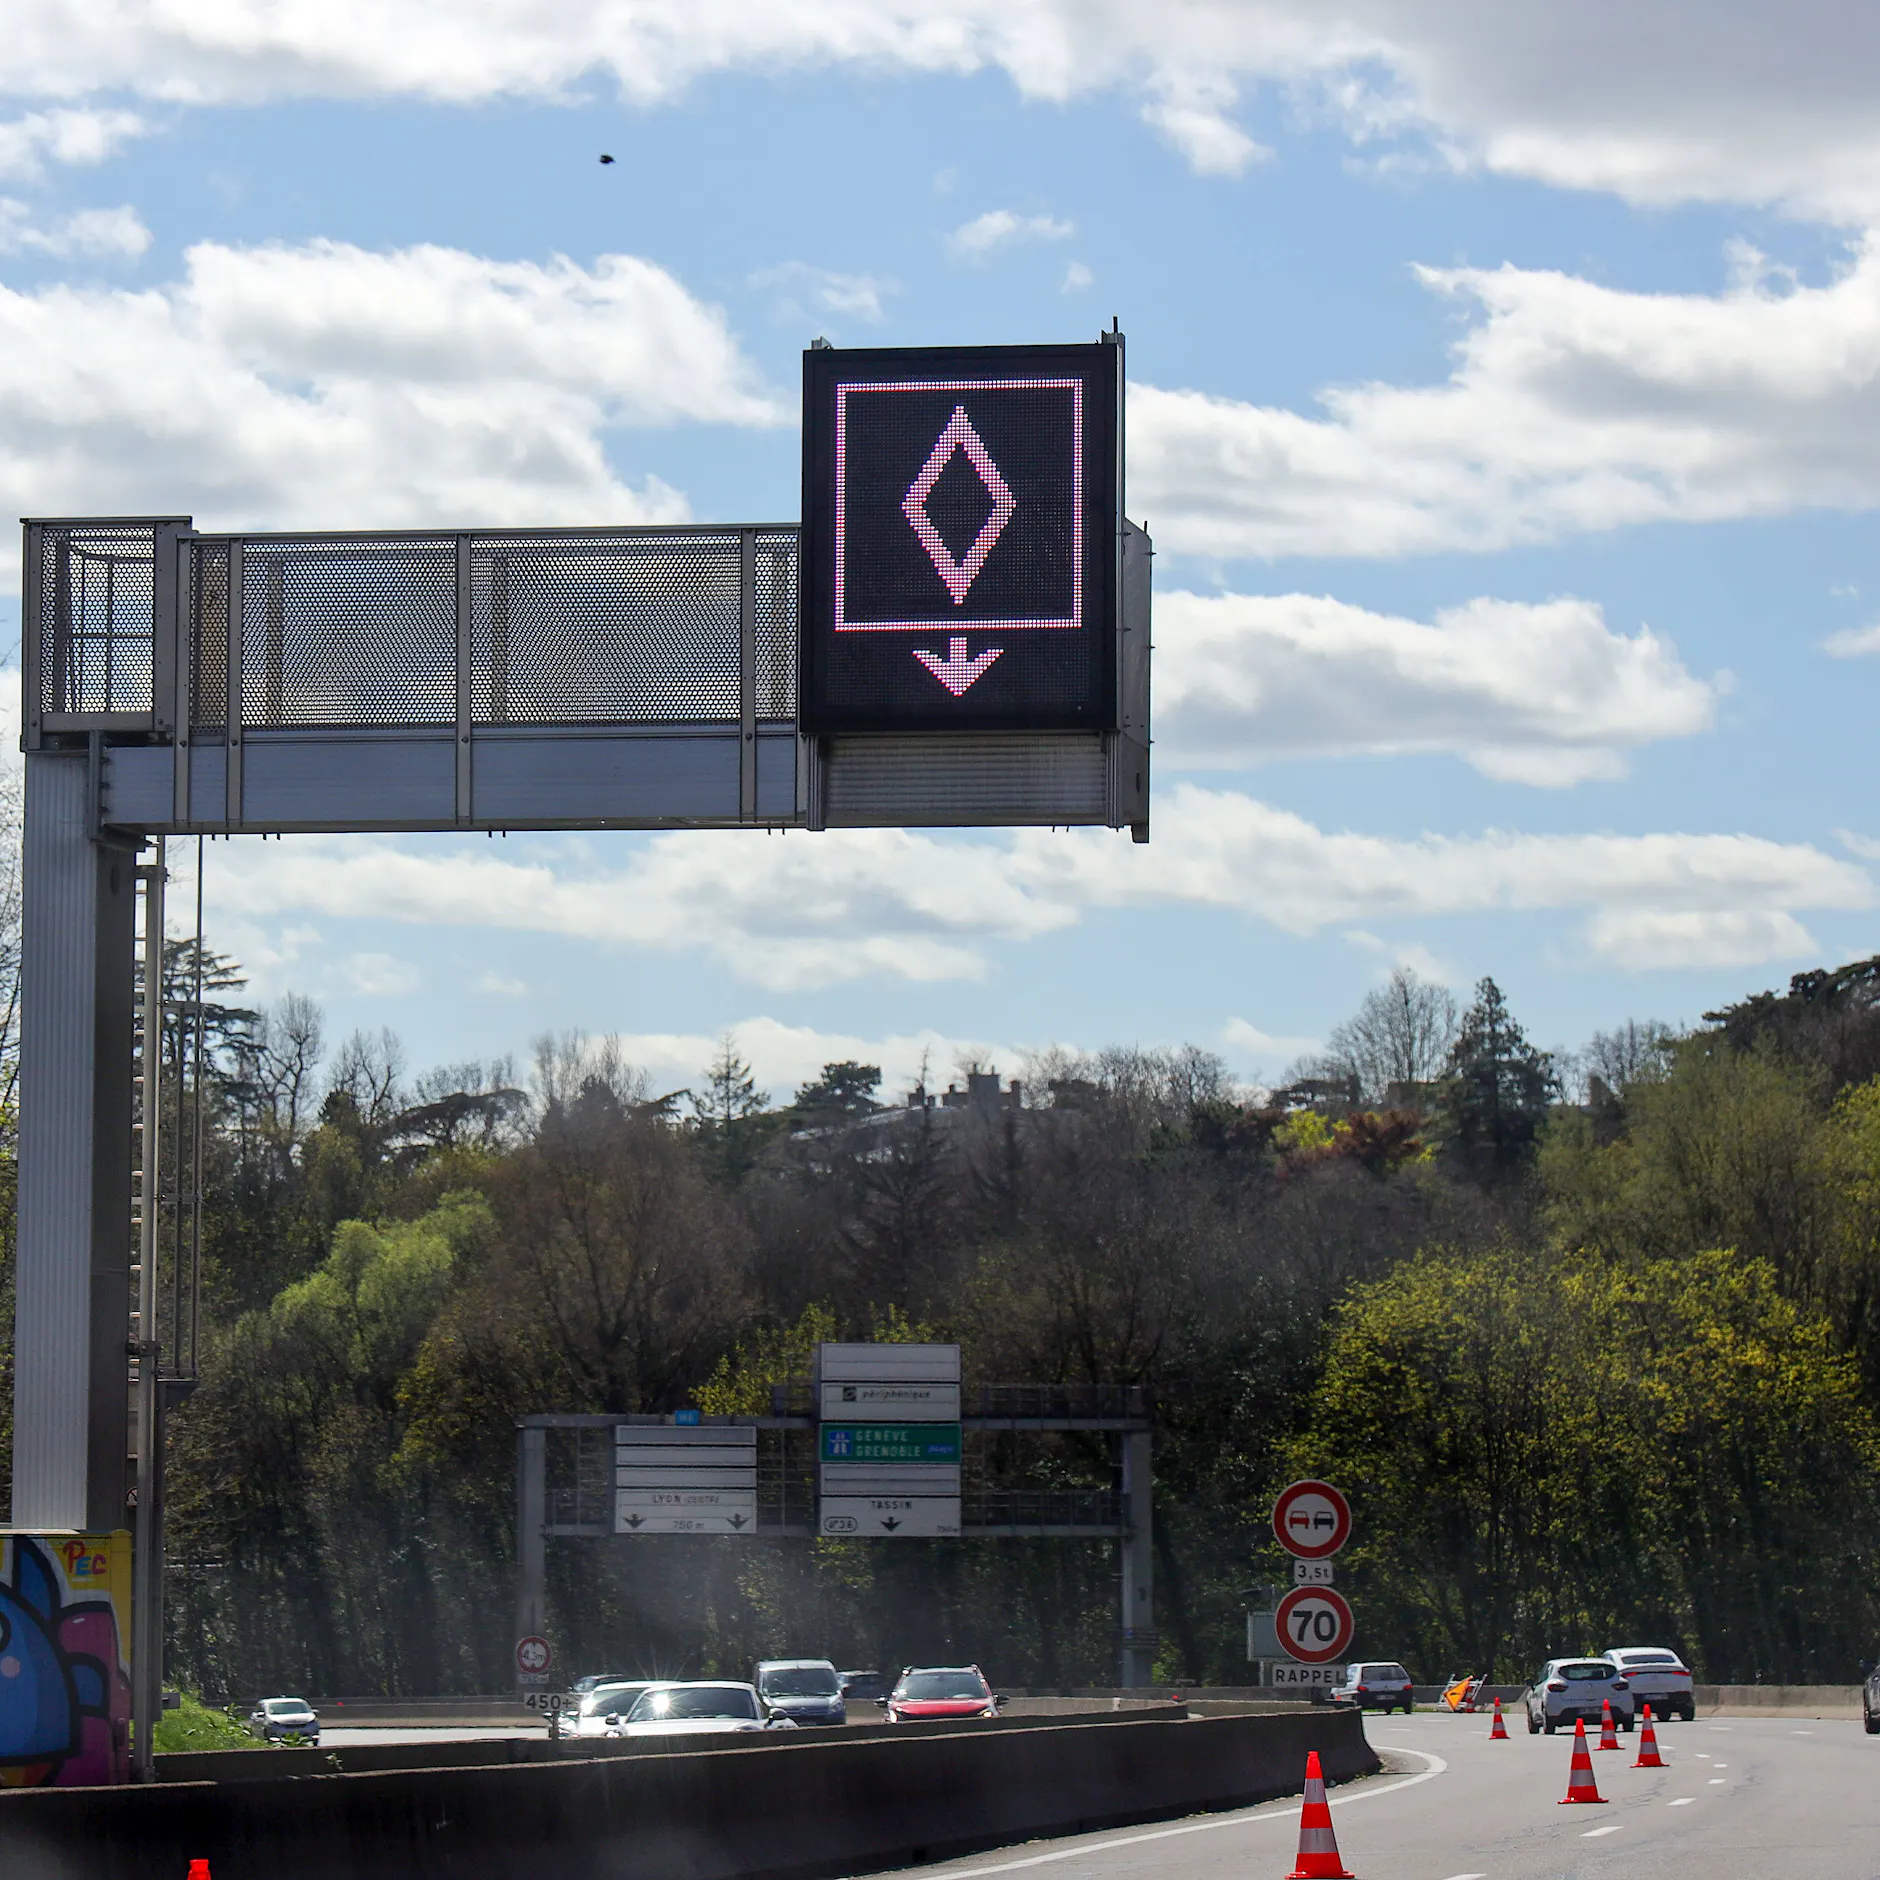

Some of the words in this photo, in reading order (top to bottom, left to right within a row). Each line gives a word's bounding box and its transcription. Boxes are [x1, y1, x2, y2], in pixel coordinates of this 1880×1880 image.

[856, 1445, 921, 1457] GRENOBLE
[651, 1494, 682, 1503] LYON
[871, 1500, 912, 1510] TASSIN
[673, 1520, 693, 1530] 750
[62, 1540, 107, 1576] PEC
[1298, 1565, 1329, 1580] 3,5t
[1292, 1610, 1337, 1642] 70
[1275, 1669, 1345, 1683] RAPPEL
